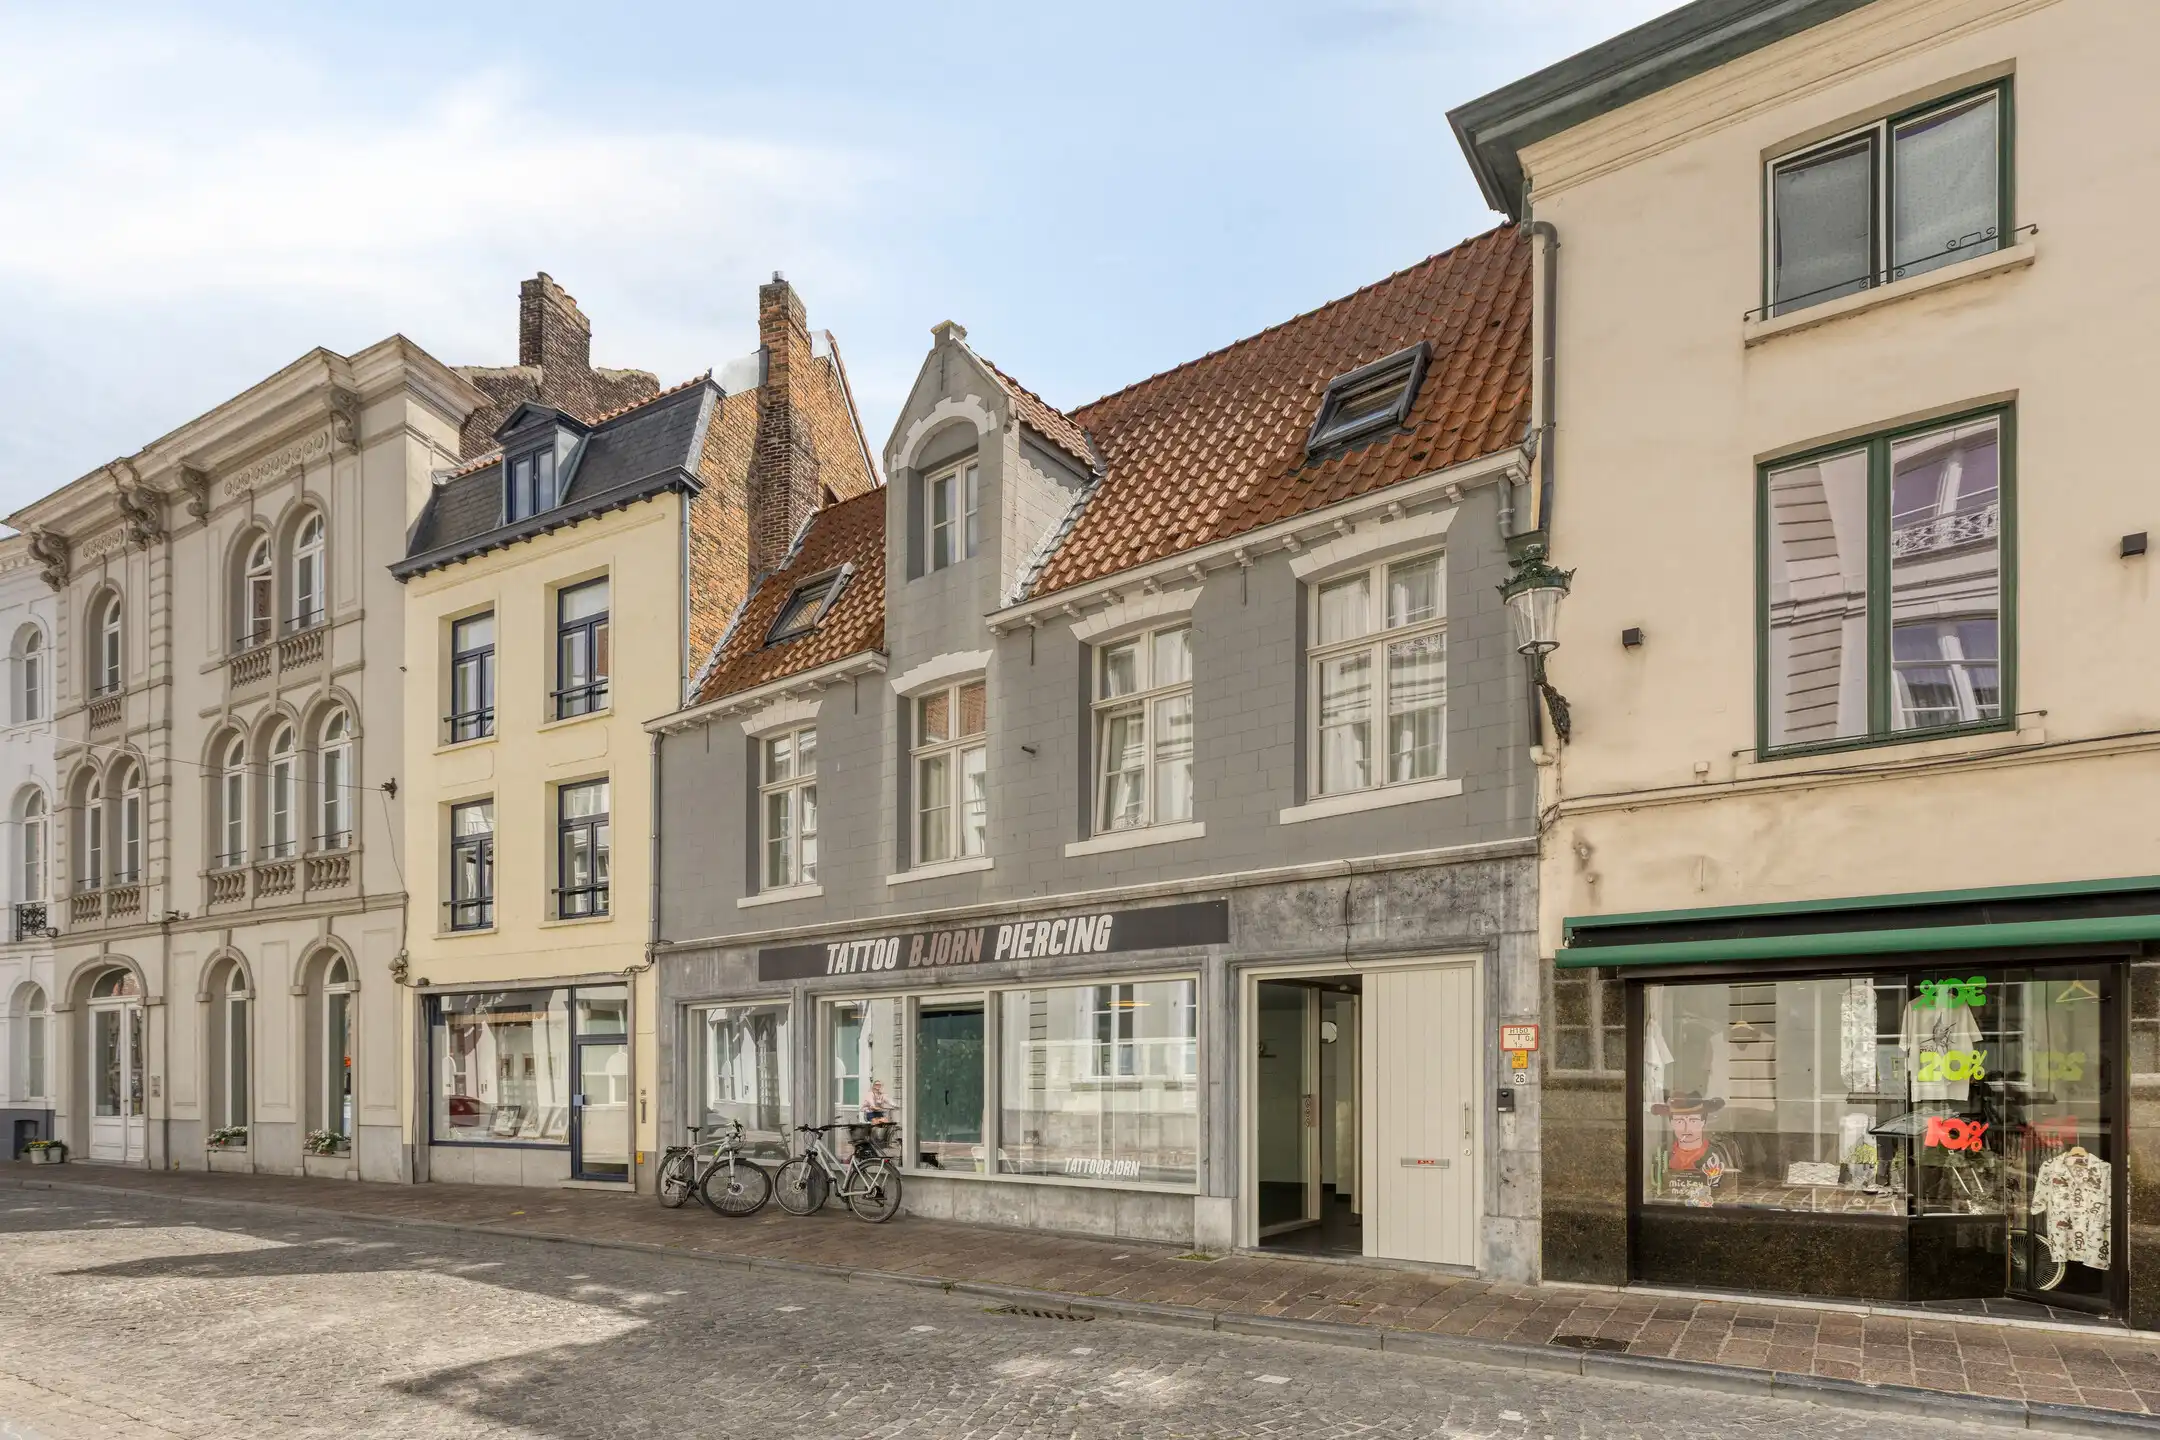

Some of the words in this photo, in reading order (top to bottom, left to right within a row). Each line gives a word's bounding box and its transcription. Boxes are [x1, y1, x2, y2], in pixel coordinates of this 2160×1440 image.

[825, 937, 900, 975] TATTOO
[908, 928, 984, 967] BJORN
[994, 914, 1114, 961] PIERCING
[1516, 1074, 1524, 1082] 26
[1917, 1050, 1988, 1082] 20%
[1924, 1116, 1989, 1152] 10%
[1064, 1157, 1141, 1176] TATTOOBJORN
